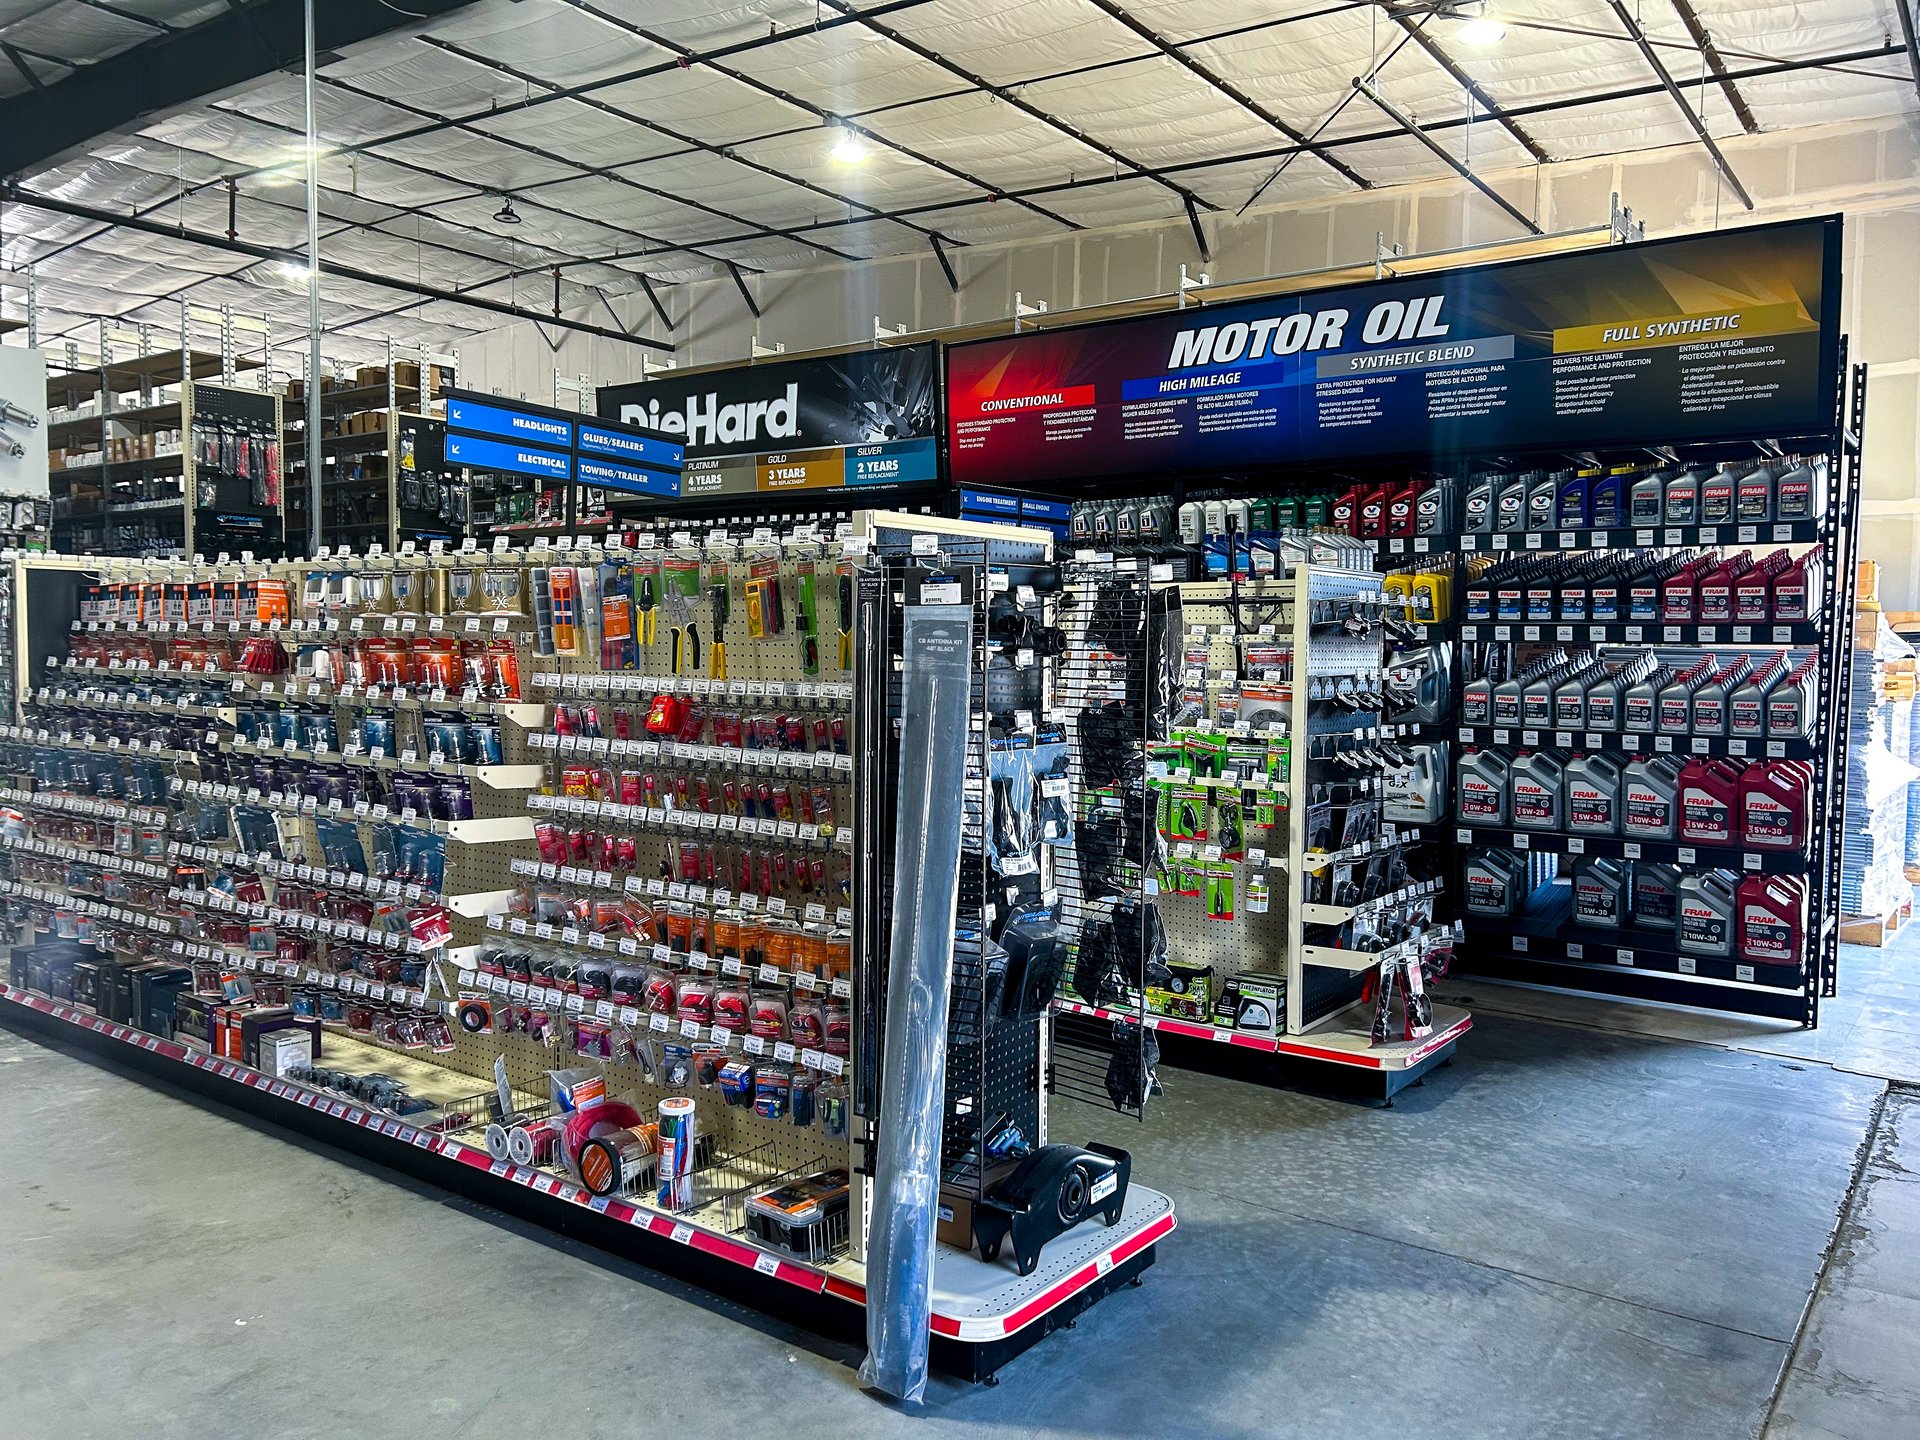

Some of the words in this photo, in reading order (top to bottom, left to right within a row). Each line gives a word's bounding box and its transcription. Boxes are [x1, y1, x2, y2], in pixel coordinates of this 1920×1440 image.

[1168, 309, 1348, 369] MOTOR
[1363, 295, 1450, 343] OIL
[1603, 325, 1640, 343] FULL
[1646, 315, 1740, 337] SYNTHETIC
[1679, 344, 1709, 352] ENTREGA
[1720, 340, 1743, 348] MEJOR
[1728, 346, 1774, 356] RENDIMIENTO
[1350, 351, 1425, 370] SYNTHETIC
[1428, 346, 1475, 362] BLEND
[1553, 357, 1580, 365] DELIVERS
[1595, 353, 1623, 361] ULTIMATE
[1461, 367, 1489, 375] ADICIONAL
[1553, 364, 1597, 374] PERFORMANCE
[1612, 358, 1651, 367] PROTECTION
[1159, 379, 1186, 392] HIGH
[1189, 372, 1241, 389] MILEAGE
[1333, 379, 1364, 388] PROTECTION
[1426, 378, 1451, 386] MOTORES
[1316, 389, 1341, 397] STRESSED
[981, 393, 1064, 412] CONVENTIONAL
[1122, 403, 1149, 411] FORMULATED
[1555, 400, 1583, 408] Exceptional
[513, 418, 567, 435] HEADLIGHTS
[583, 433, 644, 451] GLUES/SEALERS
[857, 446, 882, 456] SILVER
[518, 453, 566, 468] ELECTRICAL
[768, 456, 787, 464] GOLD
[688, 461, 719, 470] PLATINUM
[858, 463, 864, 473] 2
[867, 460, 898, 472] YEARS
[581, 465, 648, 483] TOWING/TRAILER
[768, 470, 775, 479] 3
[777, 467, 805, 478] YEARS
[688, 477, 694, 485] 4
[696, 474, 722, 485] YEARS
[993, 497, 1016, 506] TREATMENT
[1686, 798, 1714, 806] FRAM
[1634, 817, 1660, 825] 10W-30
[1578, 885, 1603, 893] FRAM
[1639, 885, 1664, 893] FRAM
[1684, 909, 1712, 917] FRAM
[1747, 916, 1777, 924] FRAM
[1689, 933, 1717, 941] 10W-30
[1753, 940, 1782, 948] 10W-30
[1241, 983, 1251, 991] TIRE
[1252, 984, 1275, 994] INFLATOR
